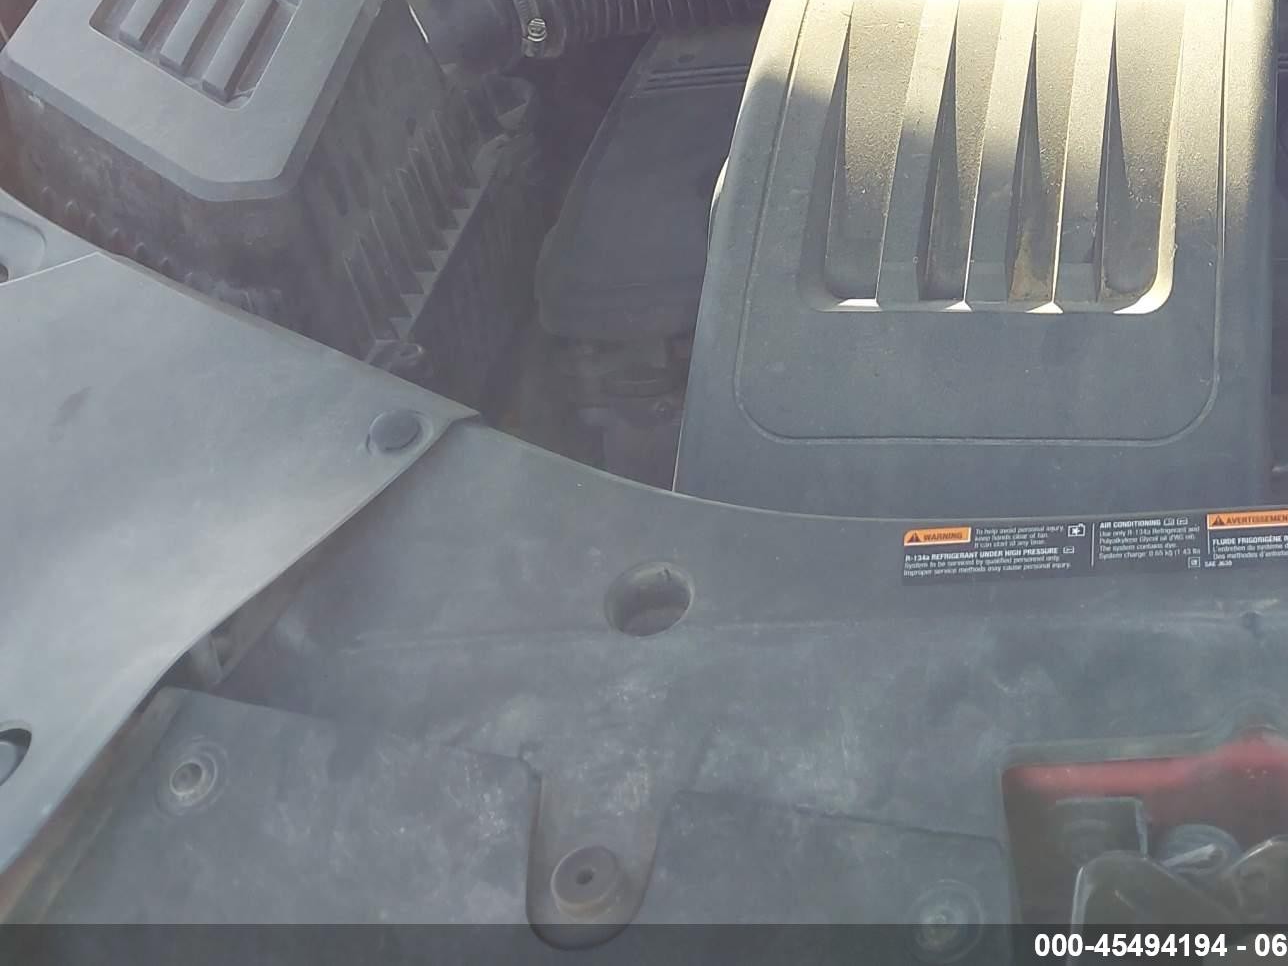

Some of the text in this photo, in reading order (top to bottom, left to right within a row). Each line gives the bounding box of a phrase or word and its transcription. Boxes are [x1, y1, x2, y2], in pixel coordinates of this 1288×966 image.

[1100, 519, 1162, 529] AIR CONDITIONING
[923, 532, 963, 541] WARNING
[1212, 537, 1236, 545] FLUIDE
[932, 552, 978, 561] REFRIGERANT
[980, 550, 1003, 558] UNDER
[1005, 549, 1021, 557] HIGH
[1023, 547, 1058, 556] PRESSURE
